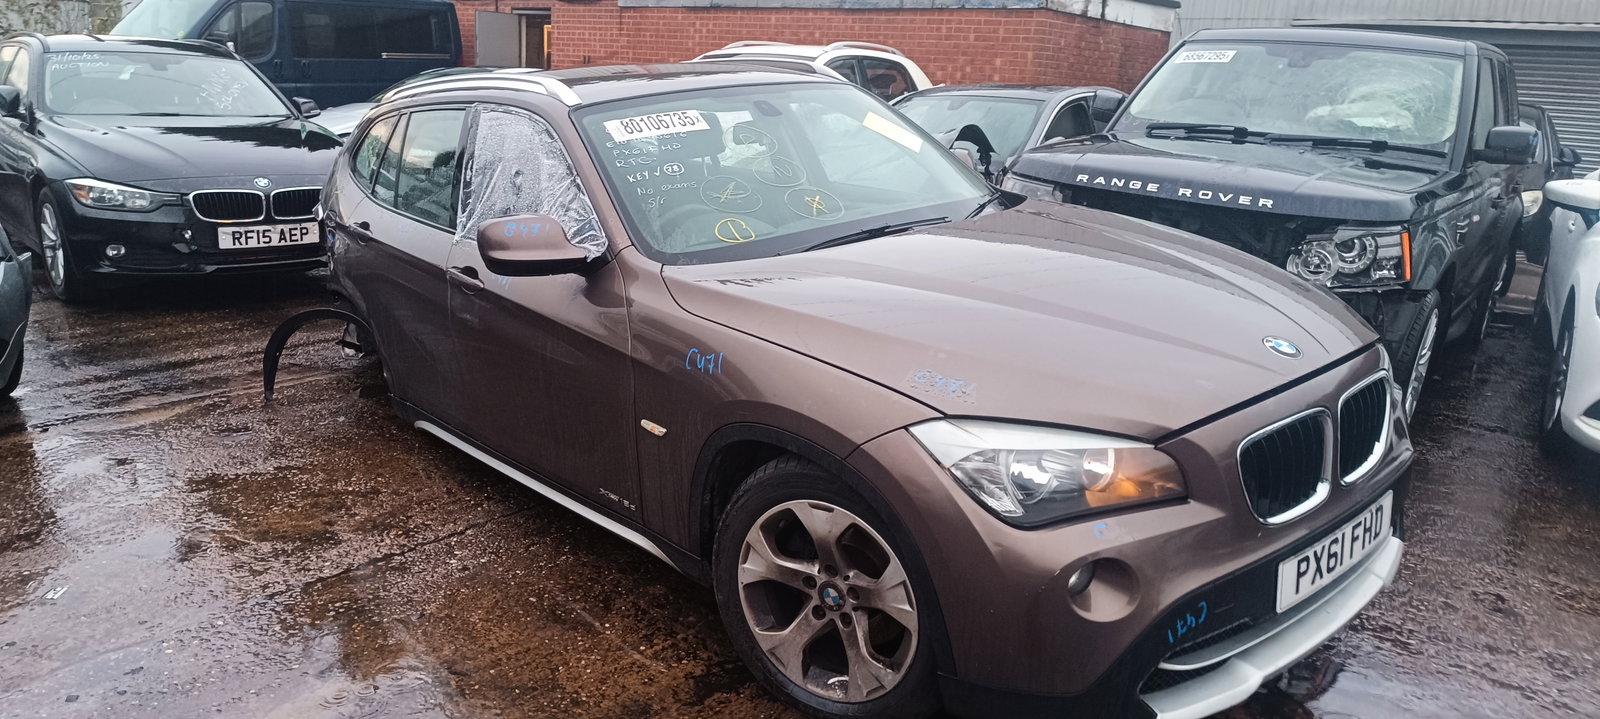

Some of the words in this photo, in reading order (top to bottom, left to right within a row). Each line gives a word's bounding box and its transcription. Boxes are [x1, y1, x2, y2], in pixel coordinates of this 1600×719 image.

[51, 61, 110, 71] AUCTION
[627, 170, 649, 183] KEY
[1076, 174, 1160, 192] RANGE
[1178, 188, 1274, 208] ROVER
[231, 229, 273, 246] RF15
[277, 226, 309, 244] AEP
[685, 347, 724, 375] C471
[1295, 531, 1346, 595] PX61
[1349, 504, 1384, 560] FHD
